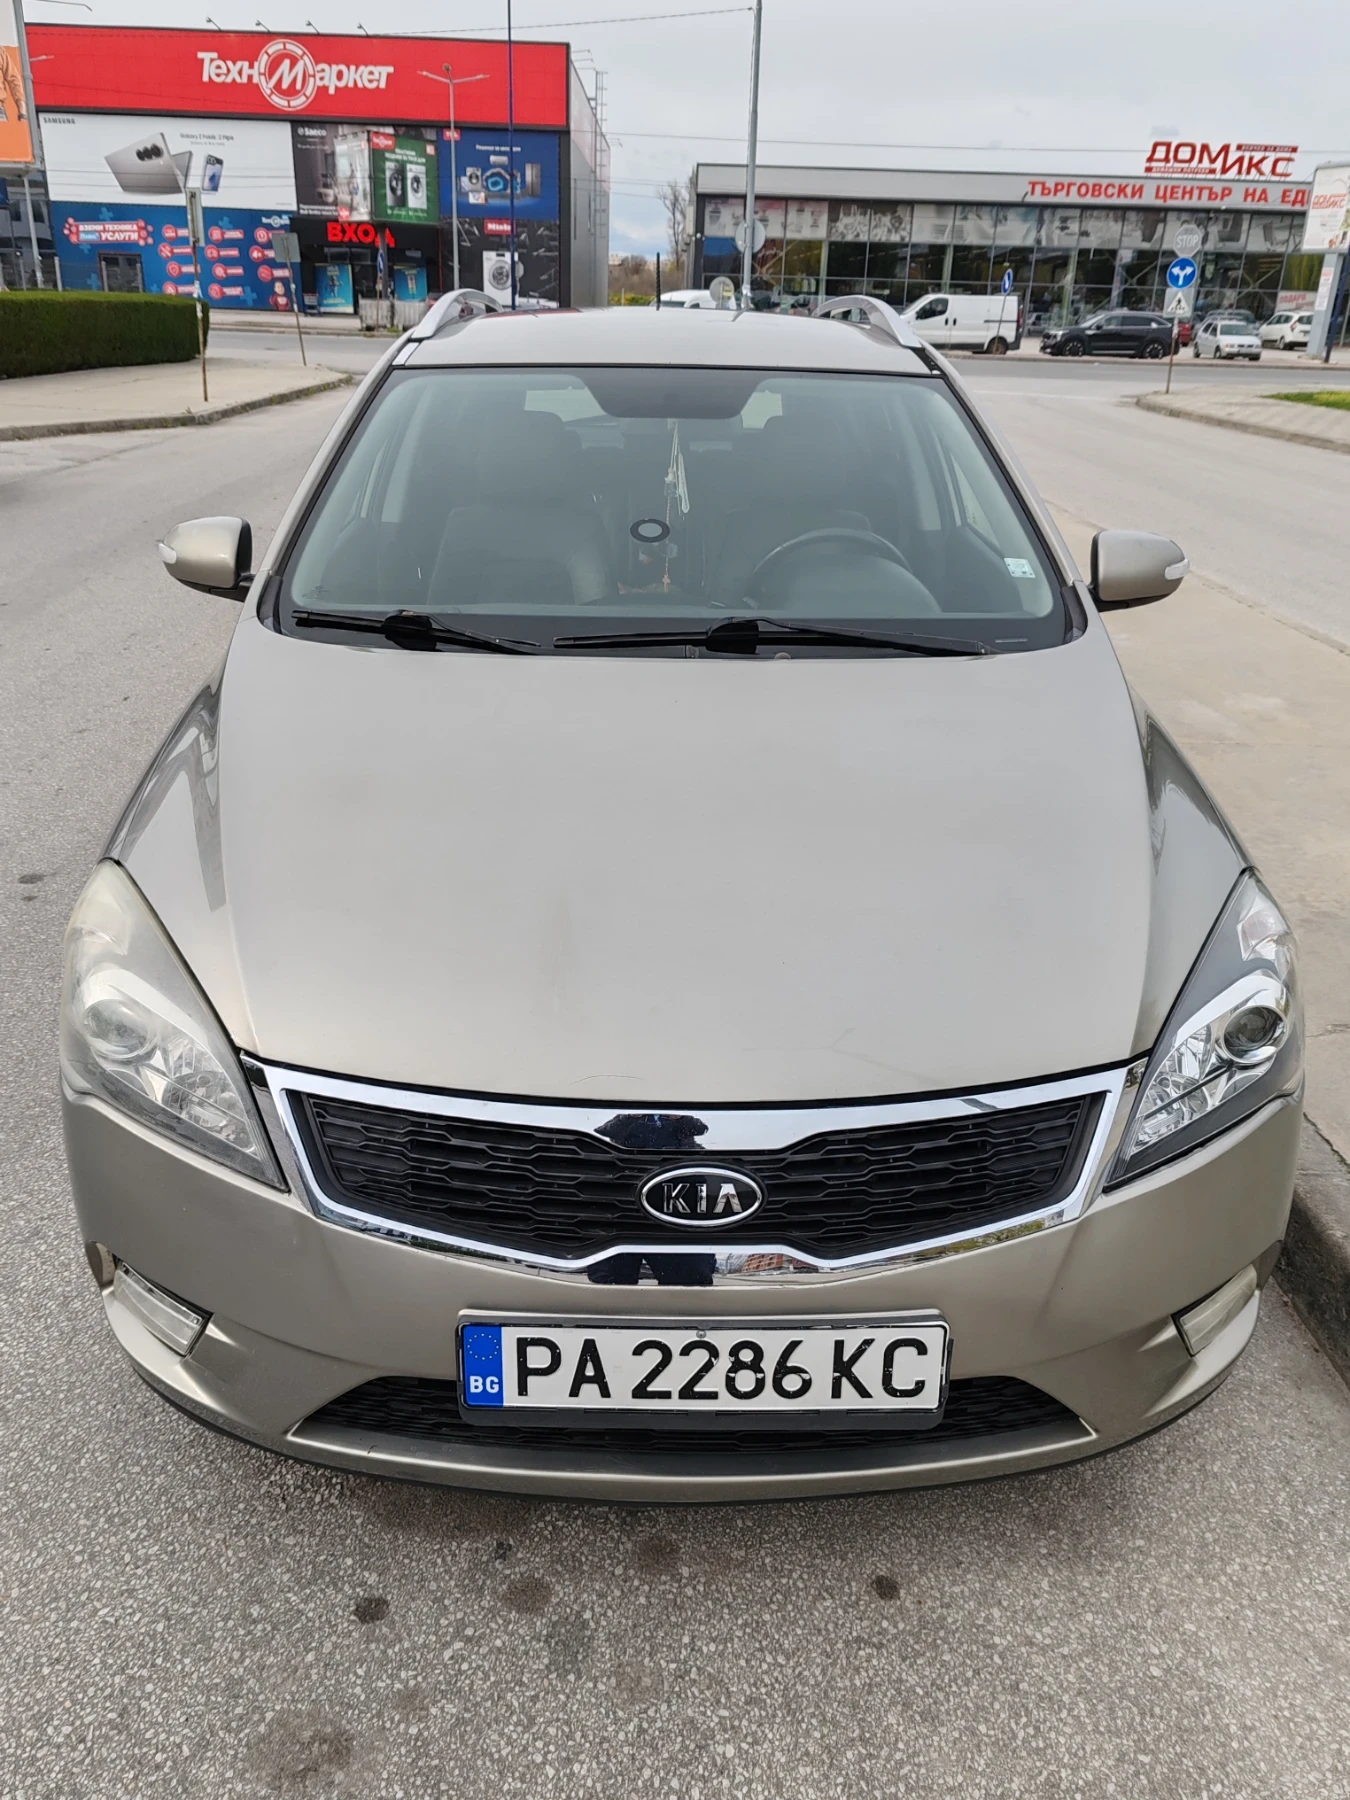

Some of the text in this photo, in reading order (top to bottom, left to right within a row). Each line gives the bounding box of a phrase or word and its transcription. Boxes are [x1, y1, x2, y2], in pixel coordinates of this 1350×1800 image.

[43, 116, 76, 125] SAMSUNG
[304, 127, 327, 136] Saeco
[1145, 141, 1296, 177] ДОМИКС
[1028, 180, 1144, 200] ТЪРГОВСКИ
[1155, 184, 1233, 203] ЦЕНТЪР
[1243, 188, 1269, 203] НА
[100, 231, 139, 240] УСЛУГИ
[1176, 234, 1199, 248] STOP
[661, 1182, 743, 1213] KIA
[516, 1336, 929, 1400] PA 2286 KC
[469, 1376, 500, 1394] BG
